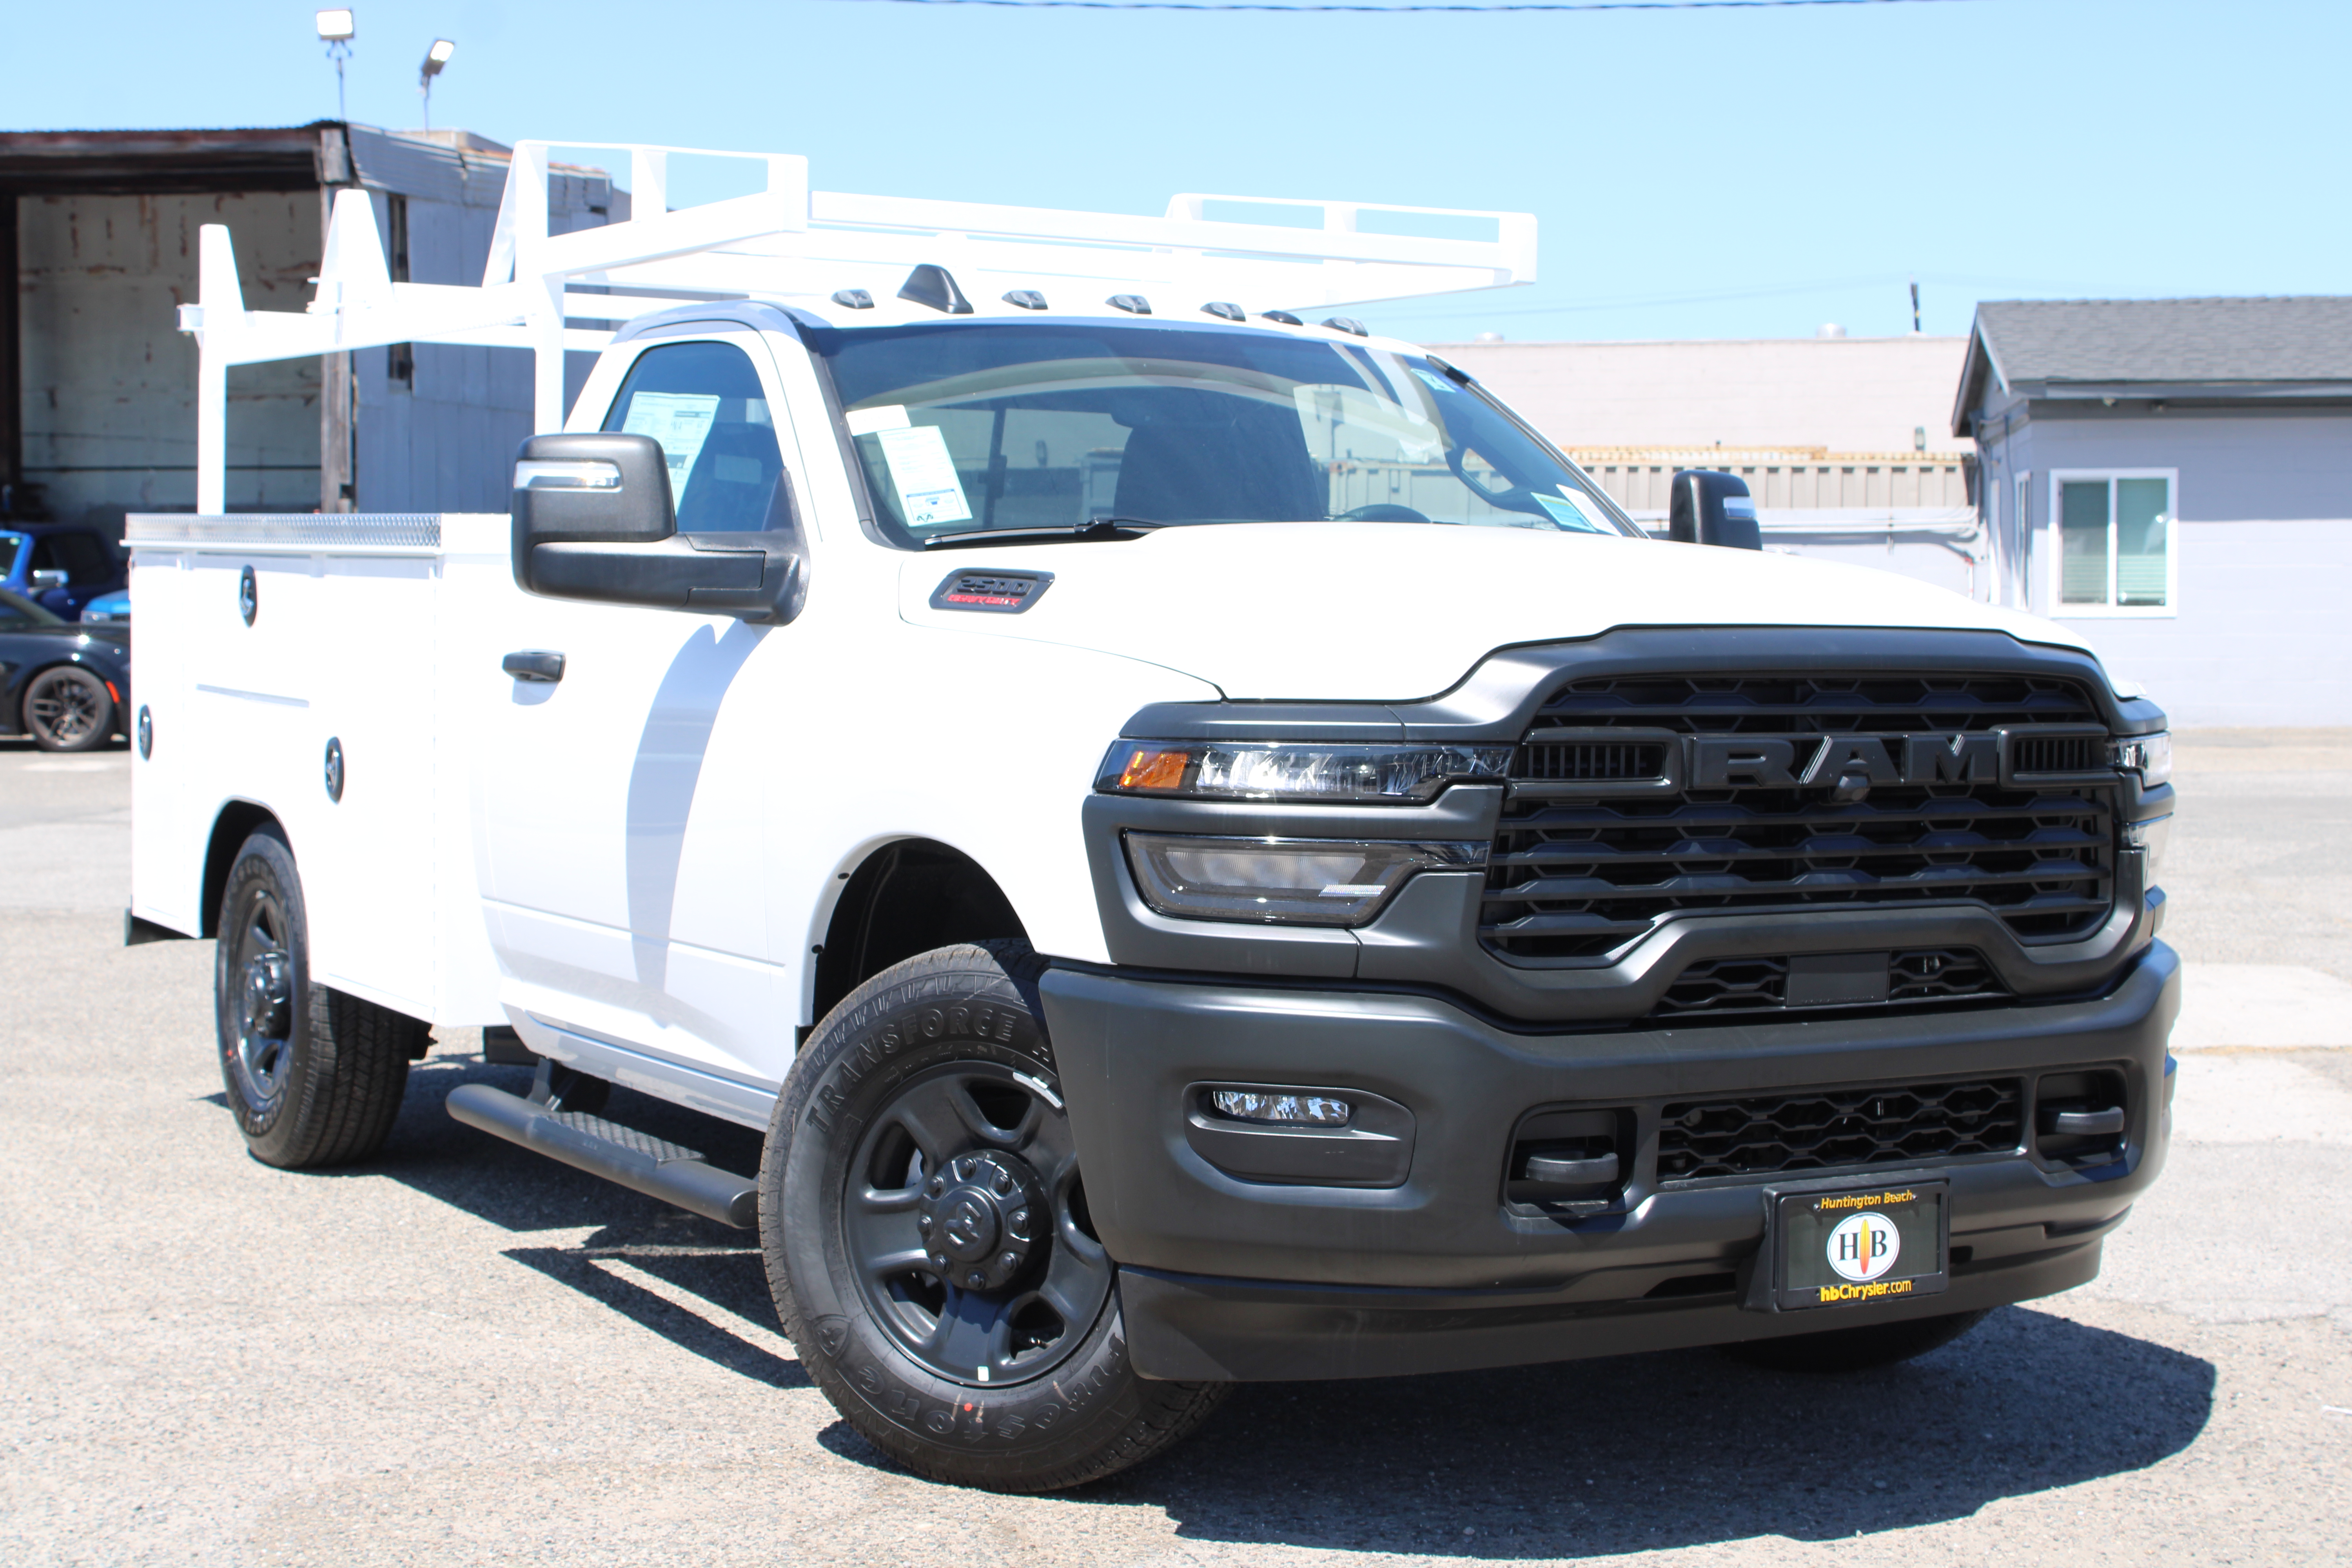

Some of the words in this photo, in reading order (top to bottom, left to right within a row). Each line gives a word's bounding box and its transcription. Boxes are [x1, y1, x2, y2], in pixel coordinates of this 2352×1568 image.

[956, 578, 1032, 596] 2500
[947, 594, 988, 603] HEAVY
[985, 596, 1021, 606] DUTY
[1689, 734, 1998, 789] RAM
[806, 1006, 1017, 1134] TRANSFORCE
[1821, 1194, 1881, 1209] Huntington
[1884, 1189, 1913, 1203] Beach
[1820, 1280, 1912, 1301] hbChrysler.com
